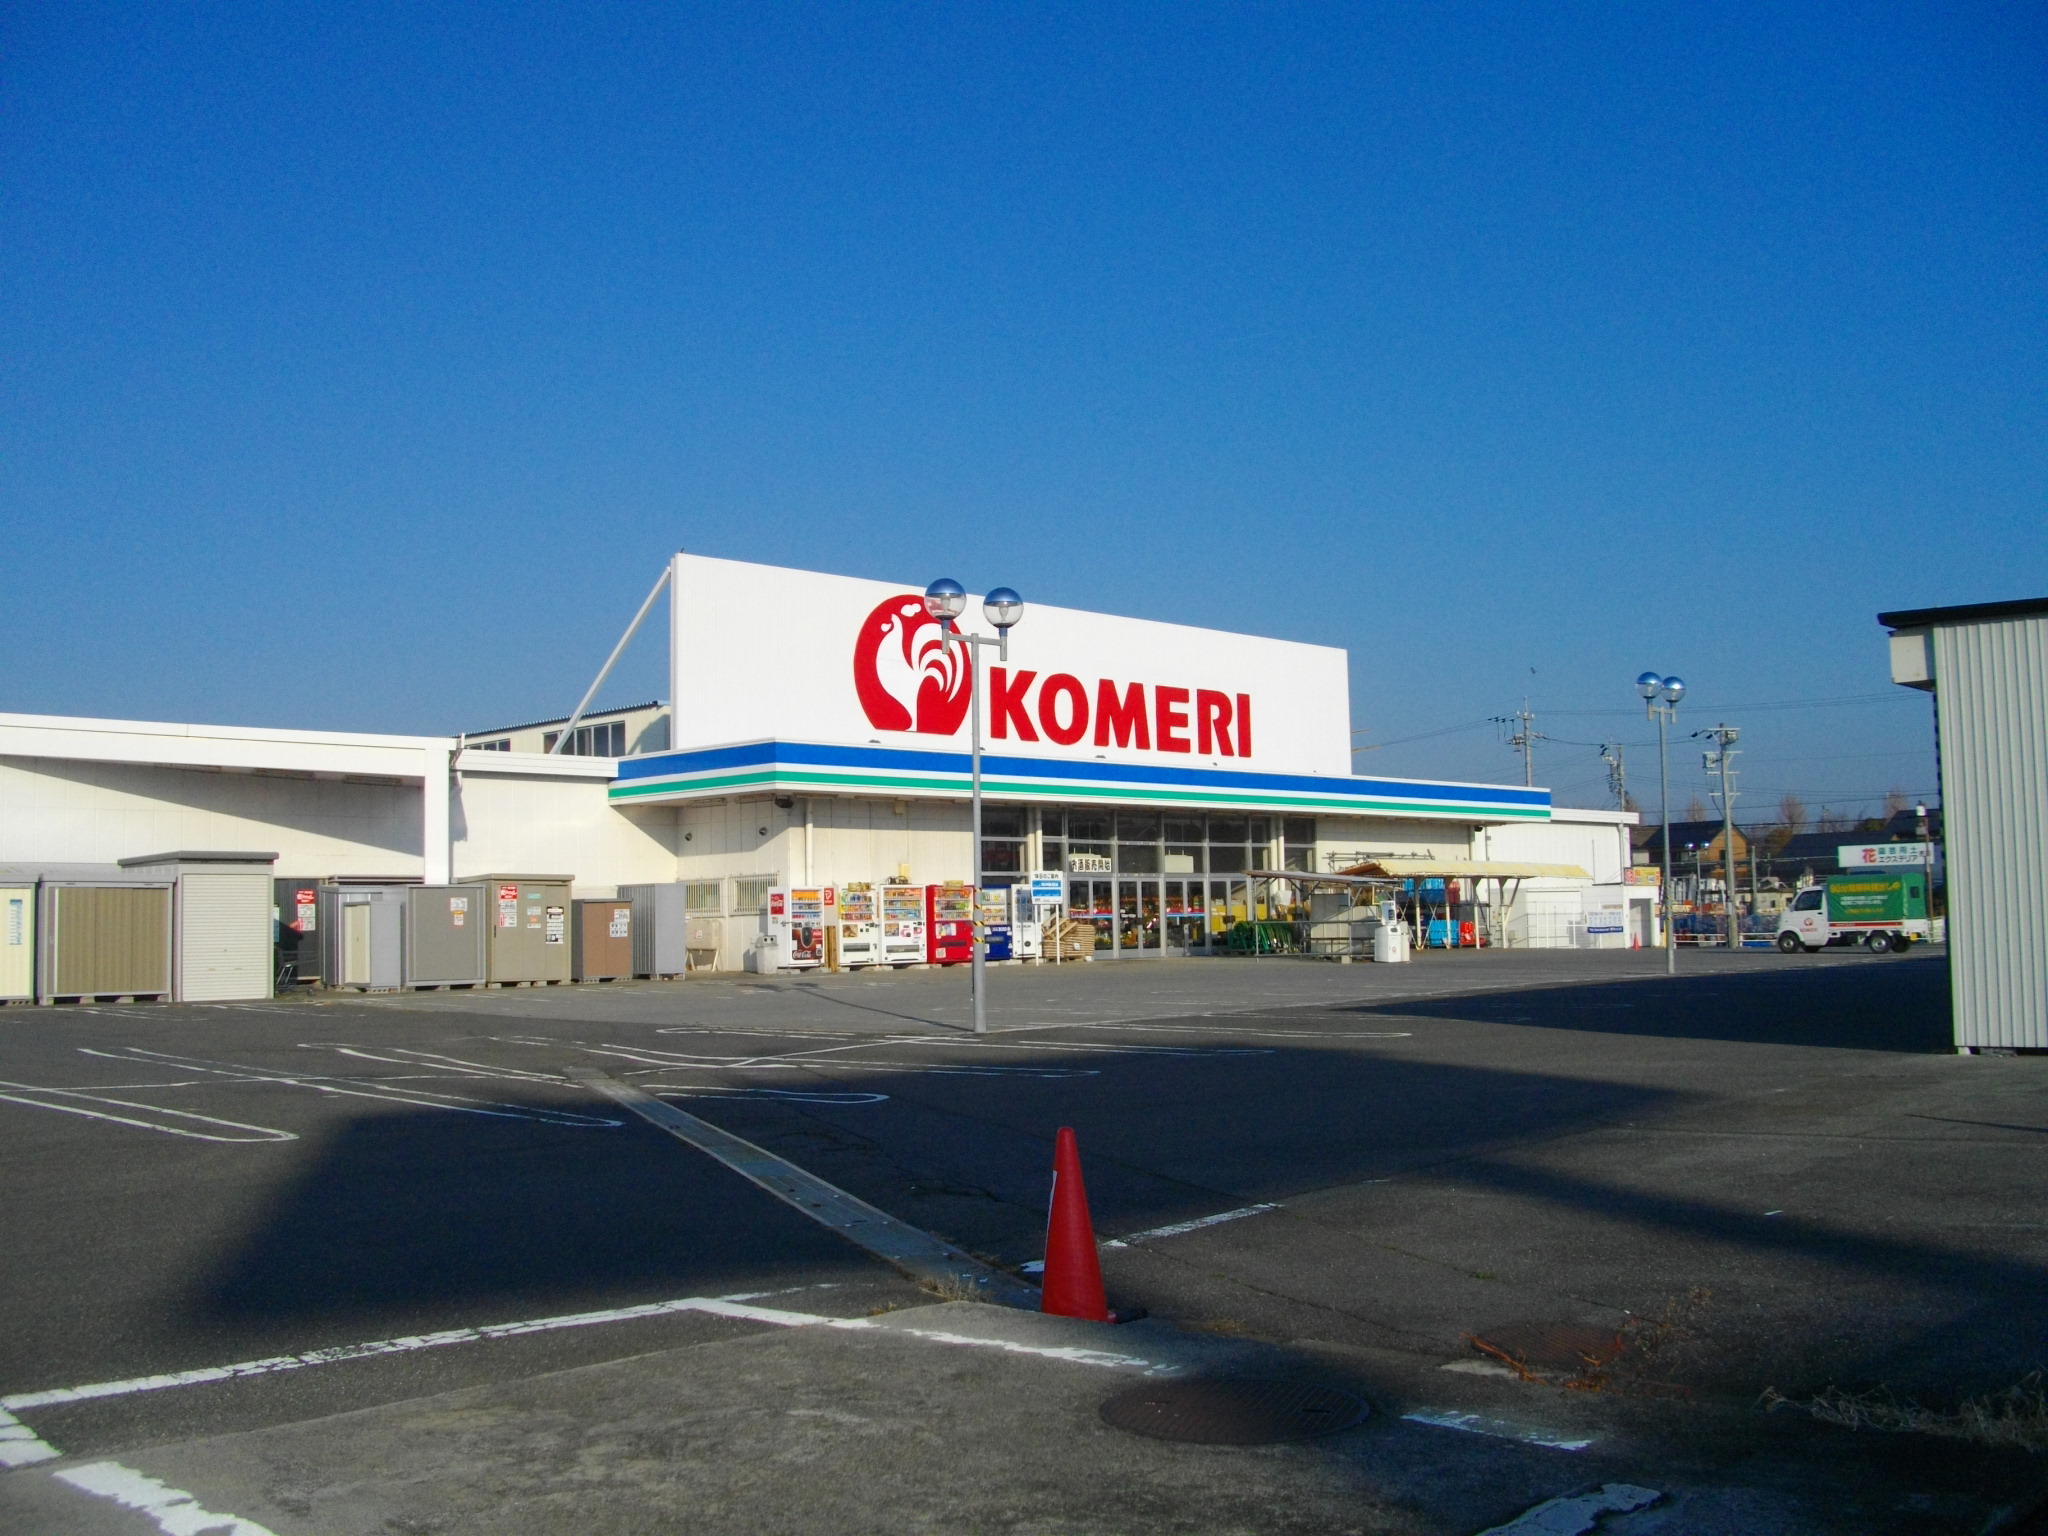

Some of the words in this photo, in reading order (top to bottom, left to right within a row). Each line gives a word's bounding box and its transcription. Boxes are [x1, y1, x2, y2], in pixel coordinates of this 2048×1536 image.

[990, 666, 1251, 758] KOMERI
[1862, 847, 1877, 863] 花
[1878, 854, 1918, 863] エクステリア
